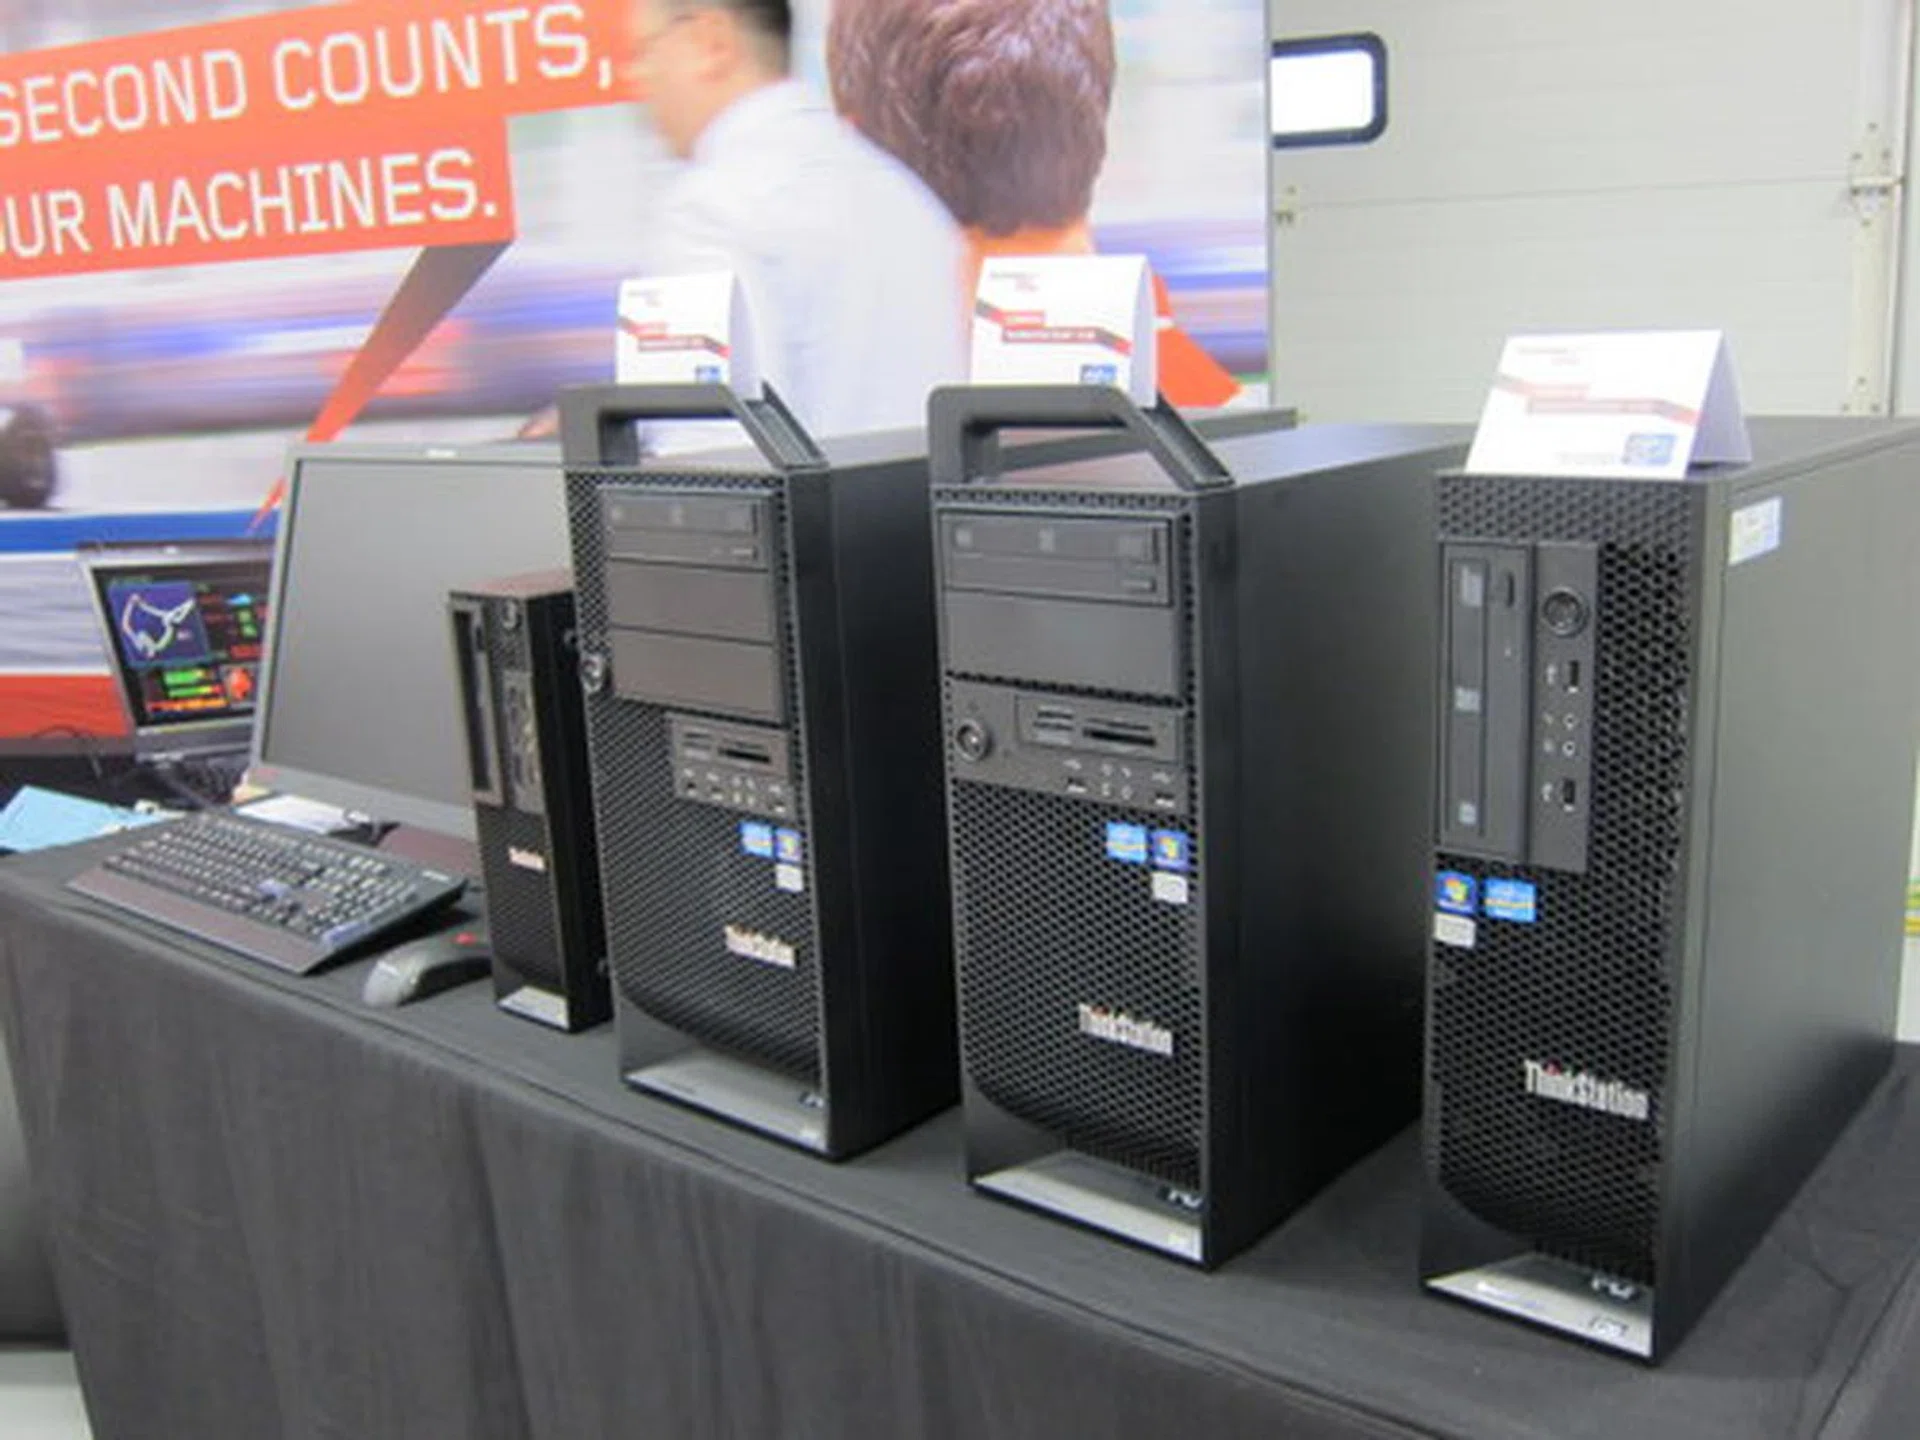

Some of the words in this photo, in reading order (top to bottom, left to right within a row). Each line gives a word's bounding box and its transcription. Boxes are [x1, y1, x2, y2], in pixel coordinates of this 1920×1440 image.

[0, 48, 247, 147] SECOND
[272, 4, 613, 110] COUNTS,
[0, 190, 92, 258] UR
[106, 147, 497, 248] MACHINES.
